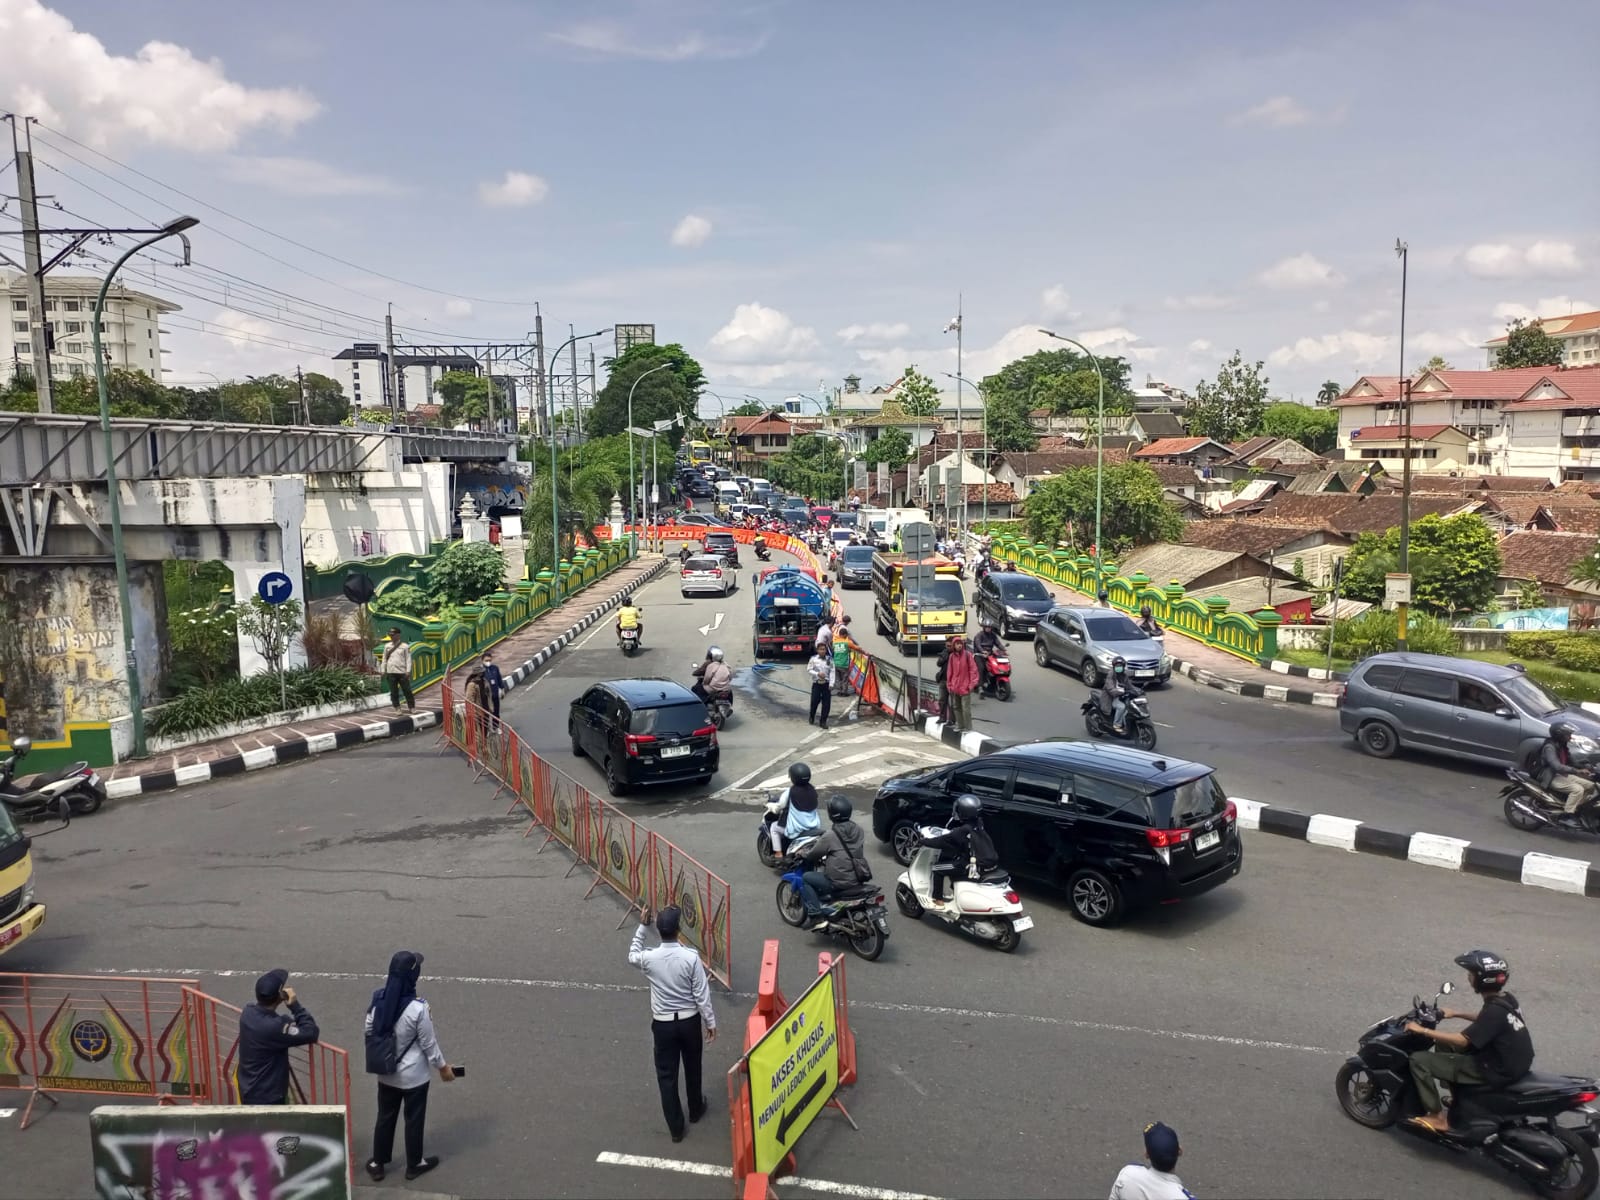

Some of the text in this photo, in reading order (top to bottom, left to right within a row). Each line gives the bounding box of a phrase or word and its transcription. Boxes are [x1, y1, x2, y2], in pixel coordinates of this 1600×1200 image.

[758, 1032, 836, 1129] MENUJU LEDOK TUKANGAN
[771, 1021, 825, 1093] AKSES KHUSUS
